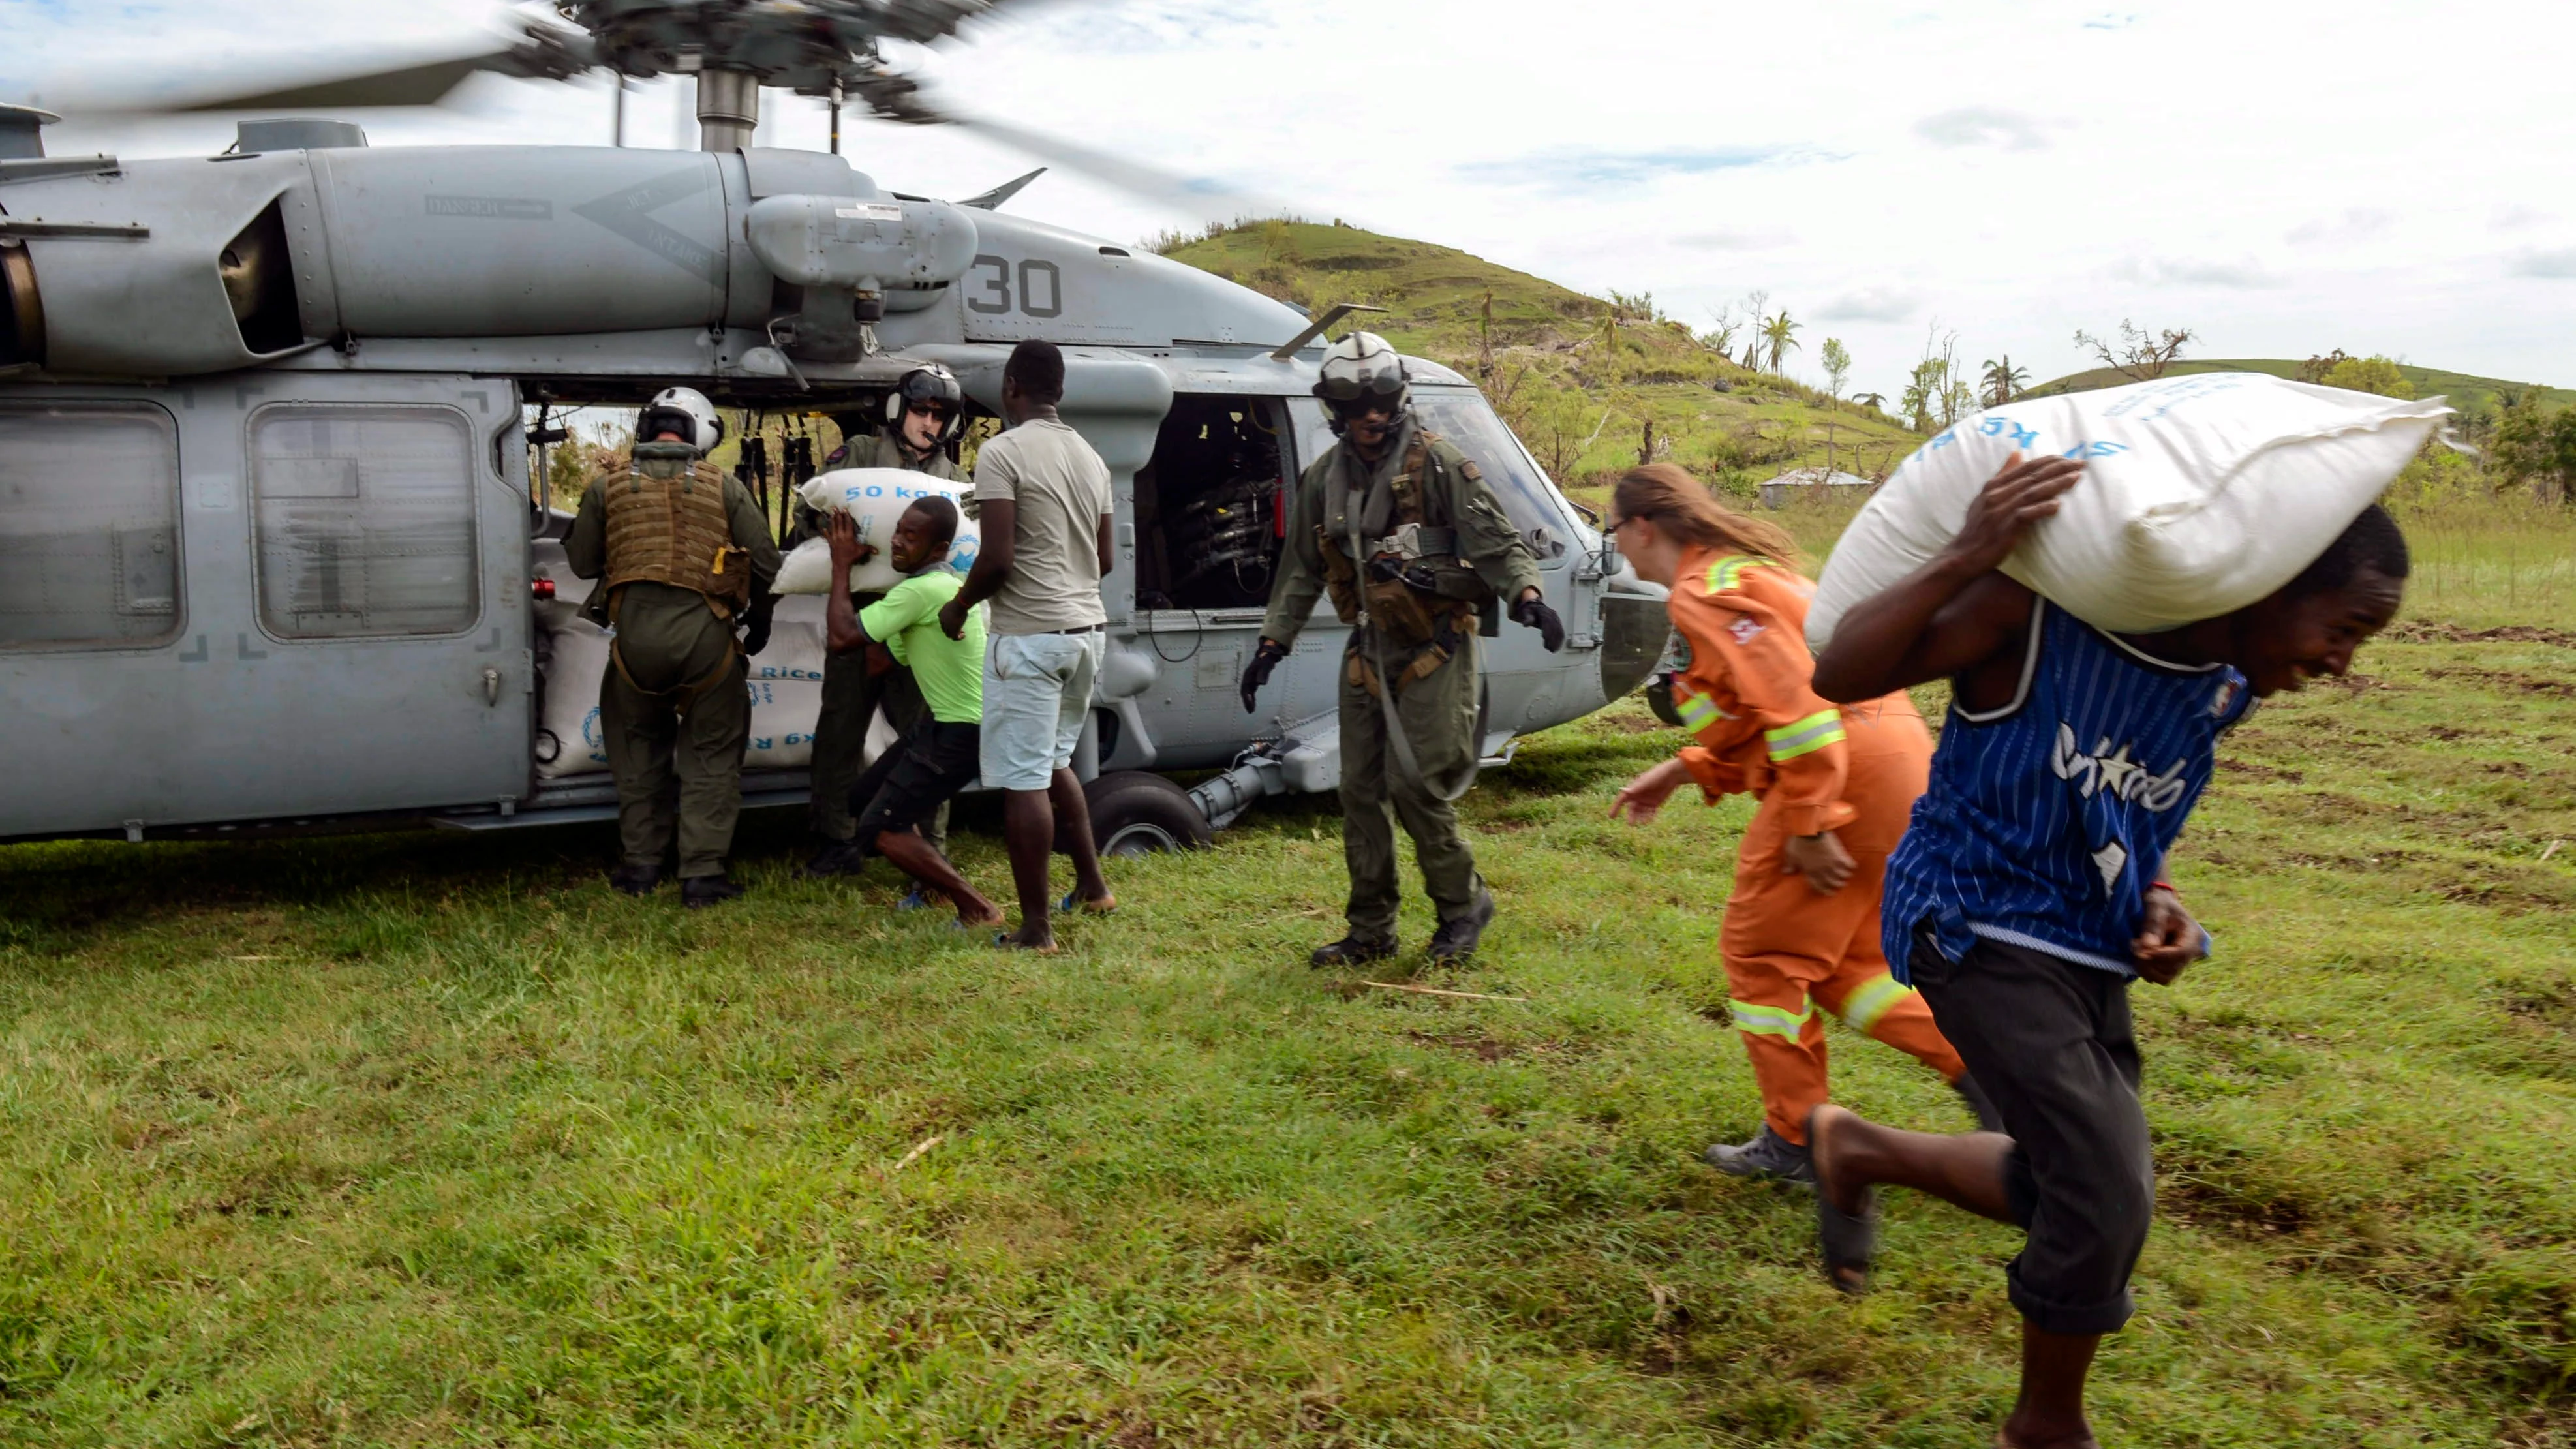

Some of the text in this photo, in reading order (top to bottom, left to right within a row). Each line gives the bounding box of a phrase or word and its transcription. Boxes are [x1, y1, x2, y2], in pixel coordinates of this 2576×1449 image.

[428, 198, 498, 215] DANGER
[968, 254, 1062, 319] 30
[846, 485, 883, 502] 50
[761, 666, 822, 680] Rice
